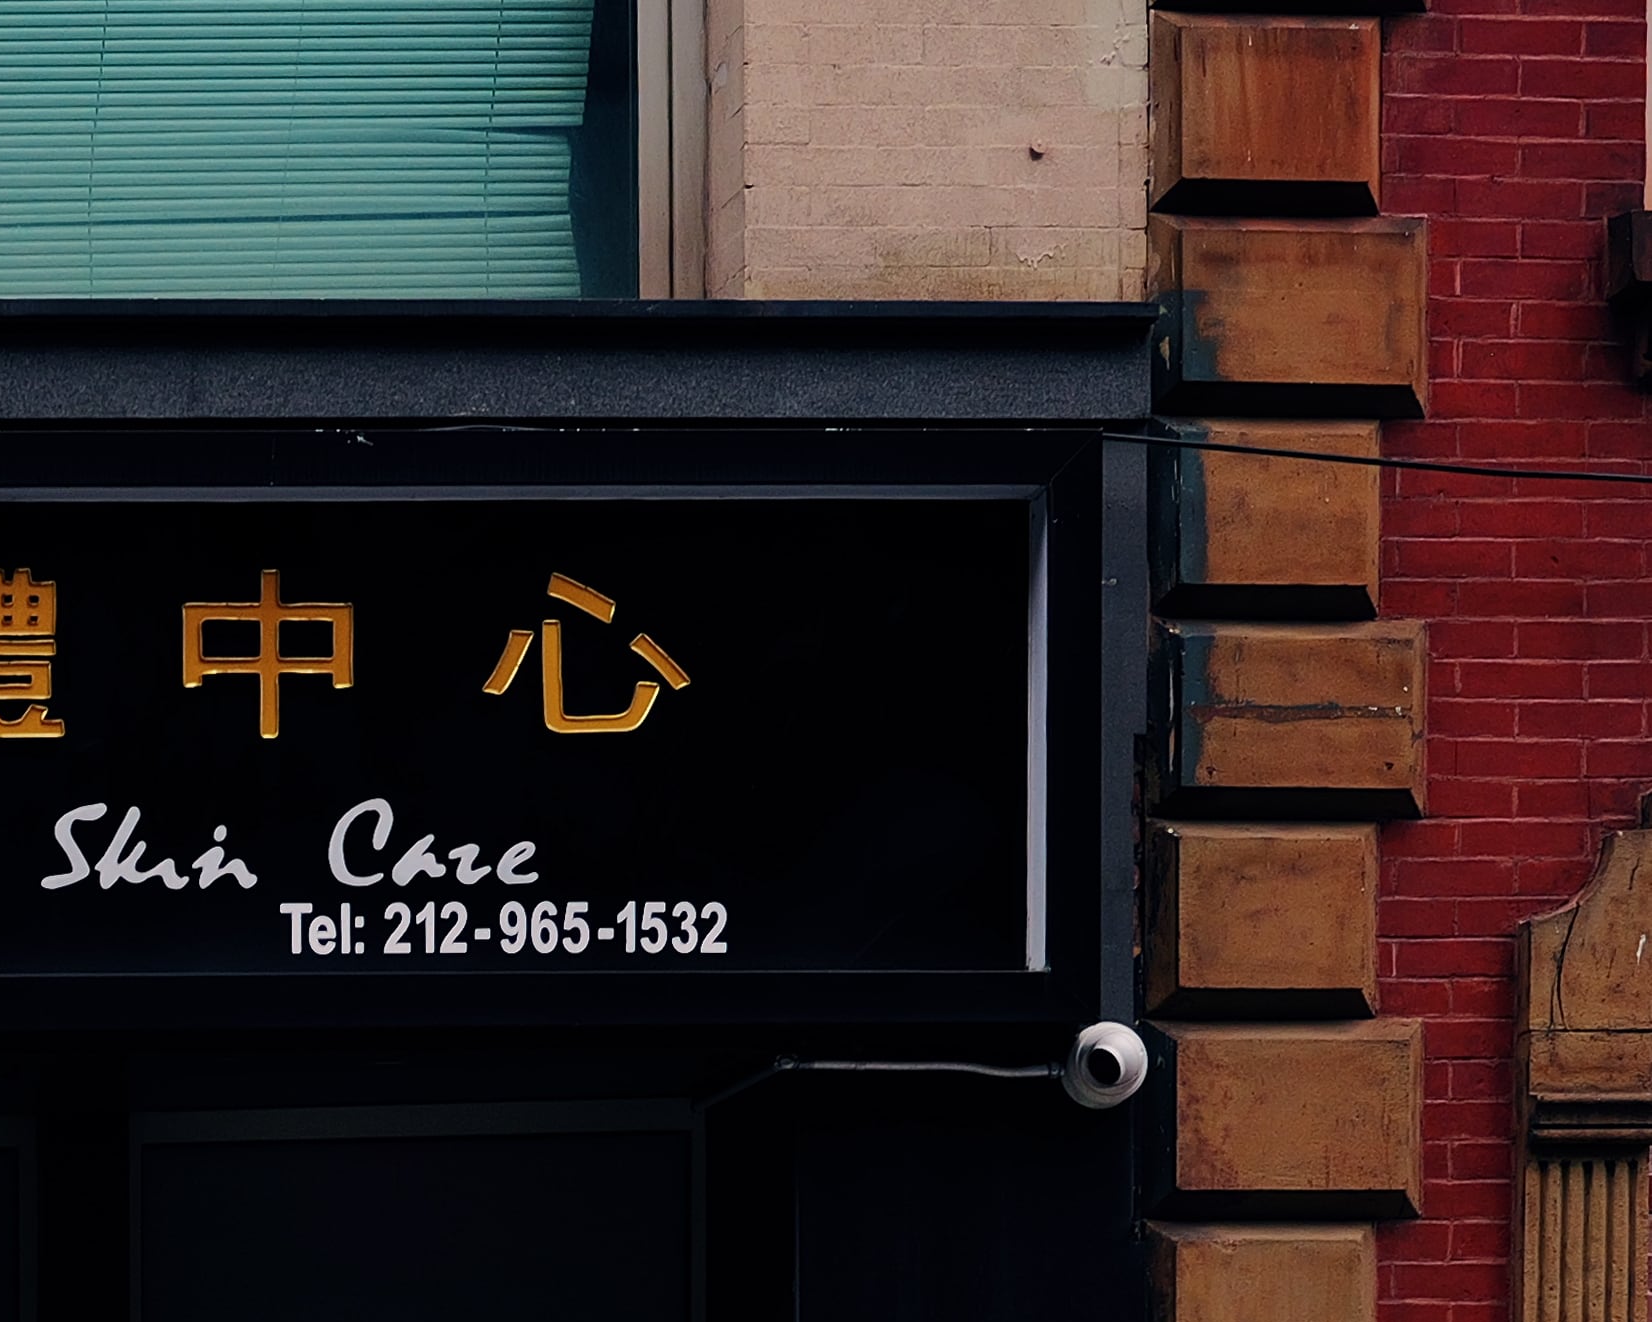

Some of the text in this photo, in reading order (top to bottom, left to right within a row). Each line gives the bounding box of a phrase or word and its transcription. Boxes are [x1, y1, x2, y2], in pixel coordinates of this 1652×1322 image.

[41, 803, 257, 889] Skin
[328, 798, 538, 886] Care
[280, 901, 727, 955] Tel: 212-965-1532
